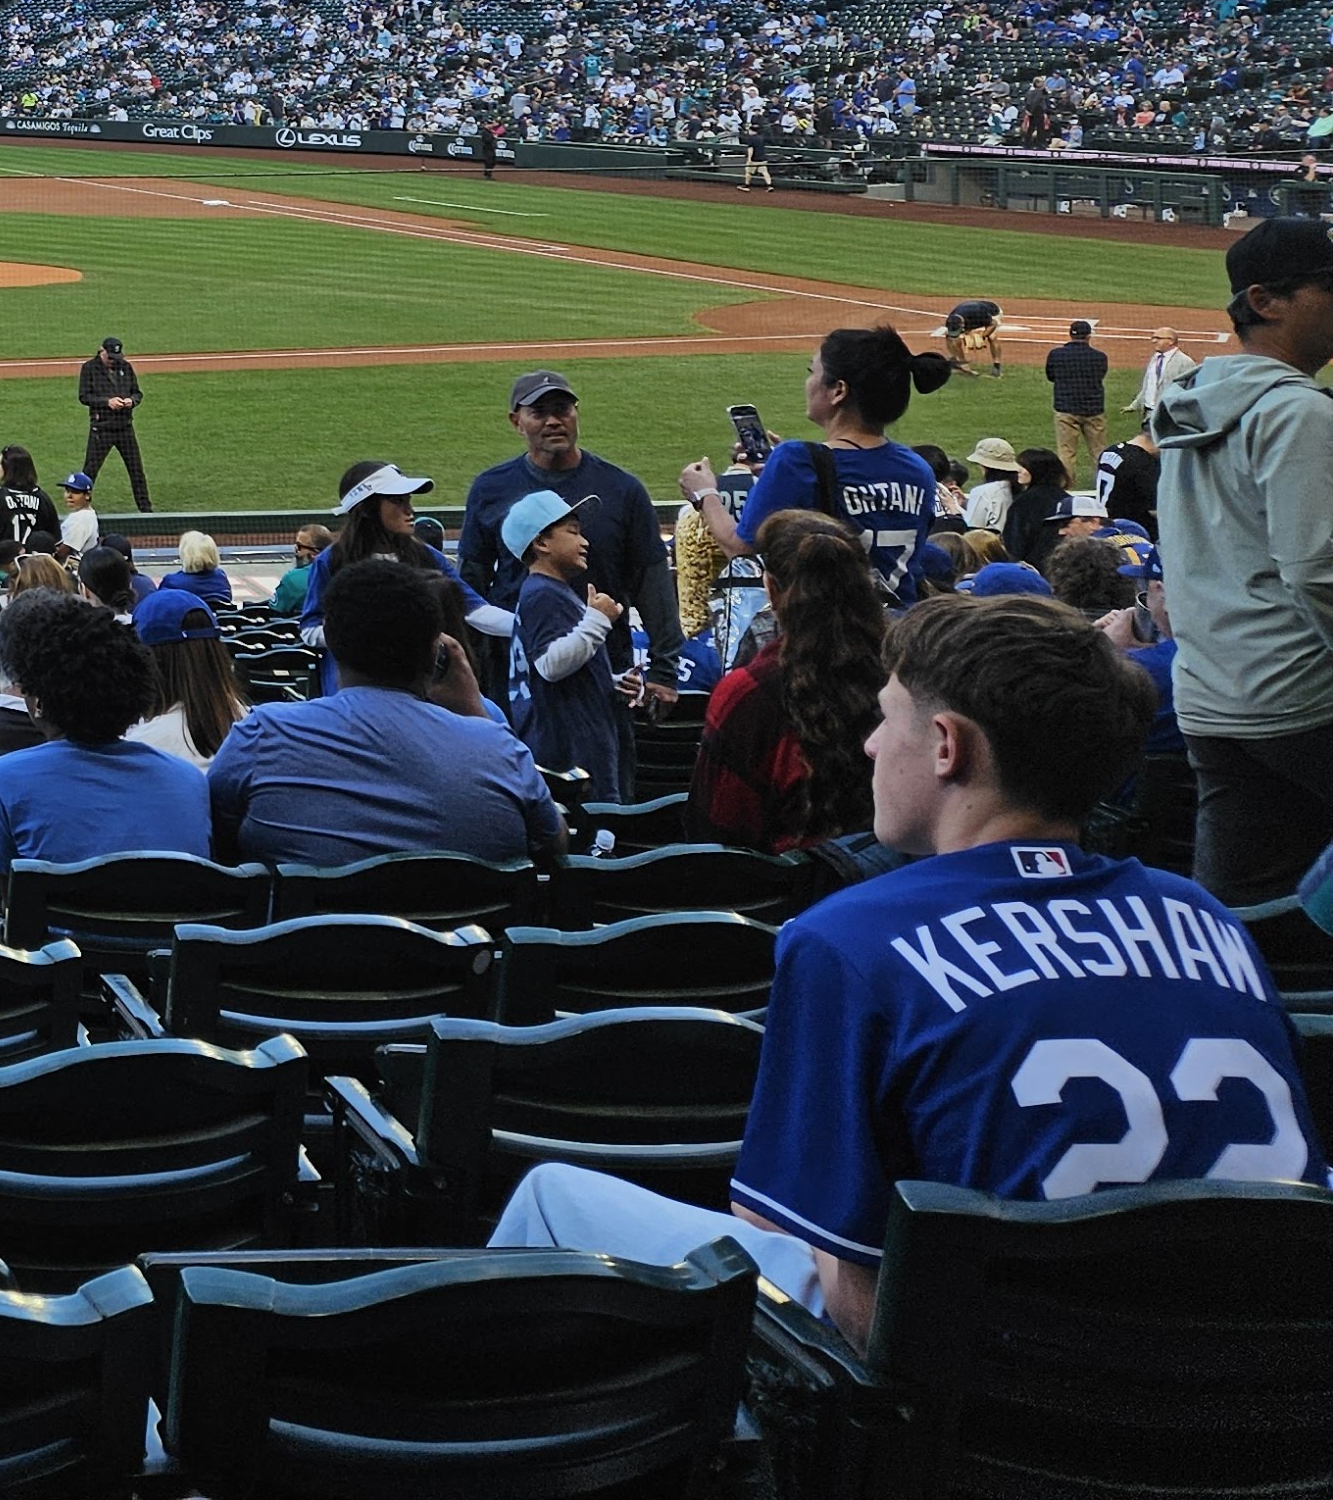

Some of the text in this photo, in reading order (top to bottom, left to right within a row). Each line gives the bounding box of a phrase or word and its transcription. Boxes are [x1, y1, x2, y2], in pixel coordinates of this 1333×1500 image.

[142, 124, 214, 144] Great Clips
[297, 132, 362, 148] LEXUS
[842, 481, 926, 517] OHTANI
[889, 895, 1268, 1014] KERSHAW
